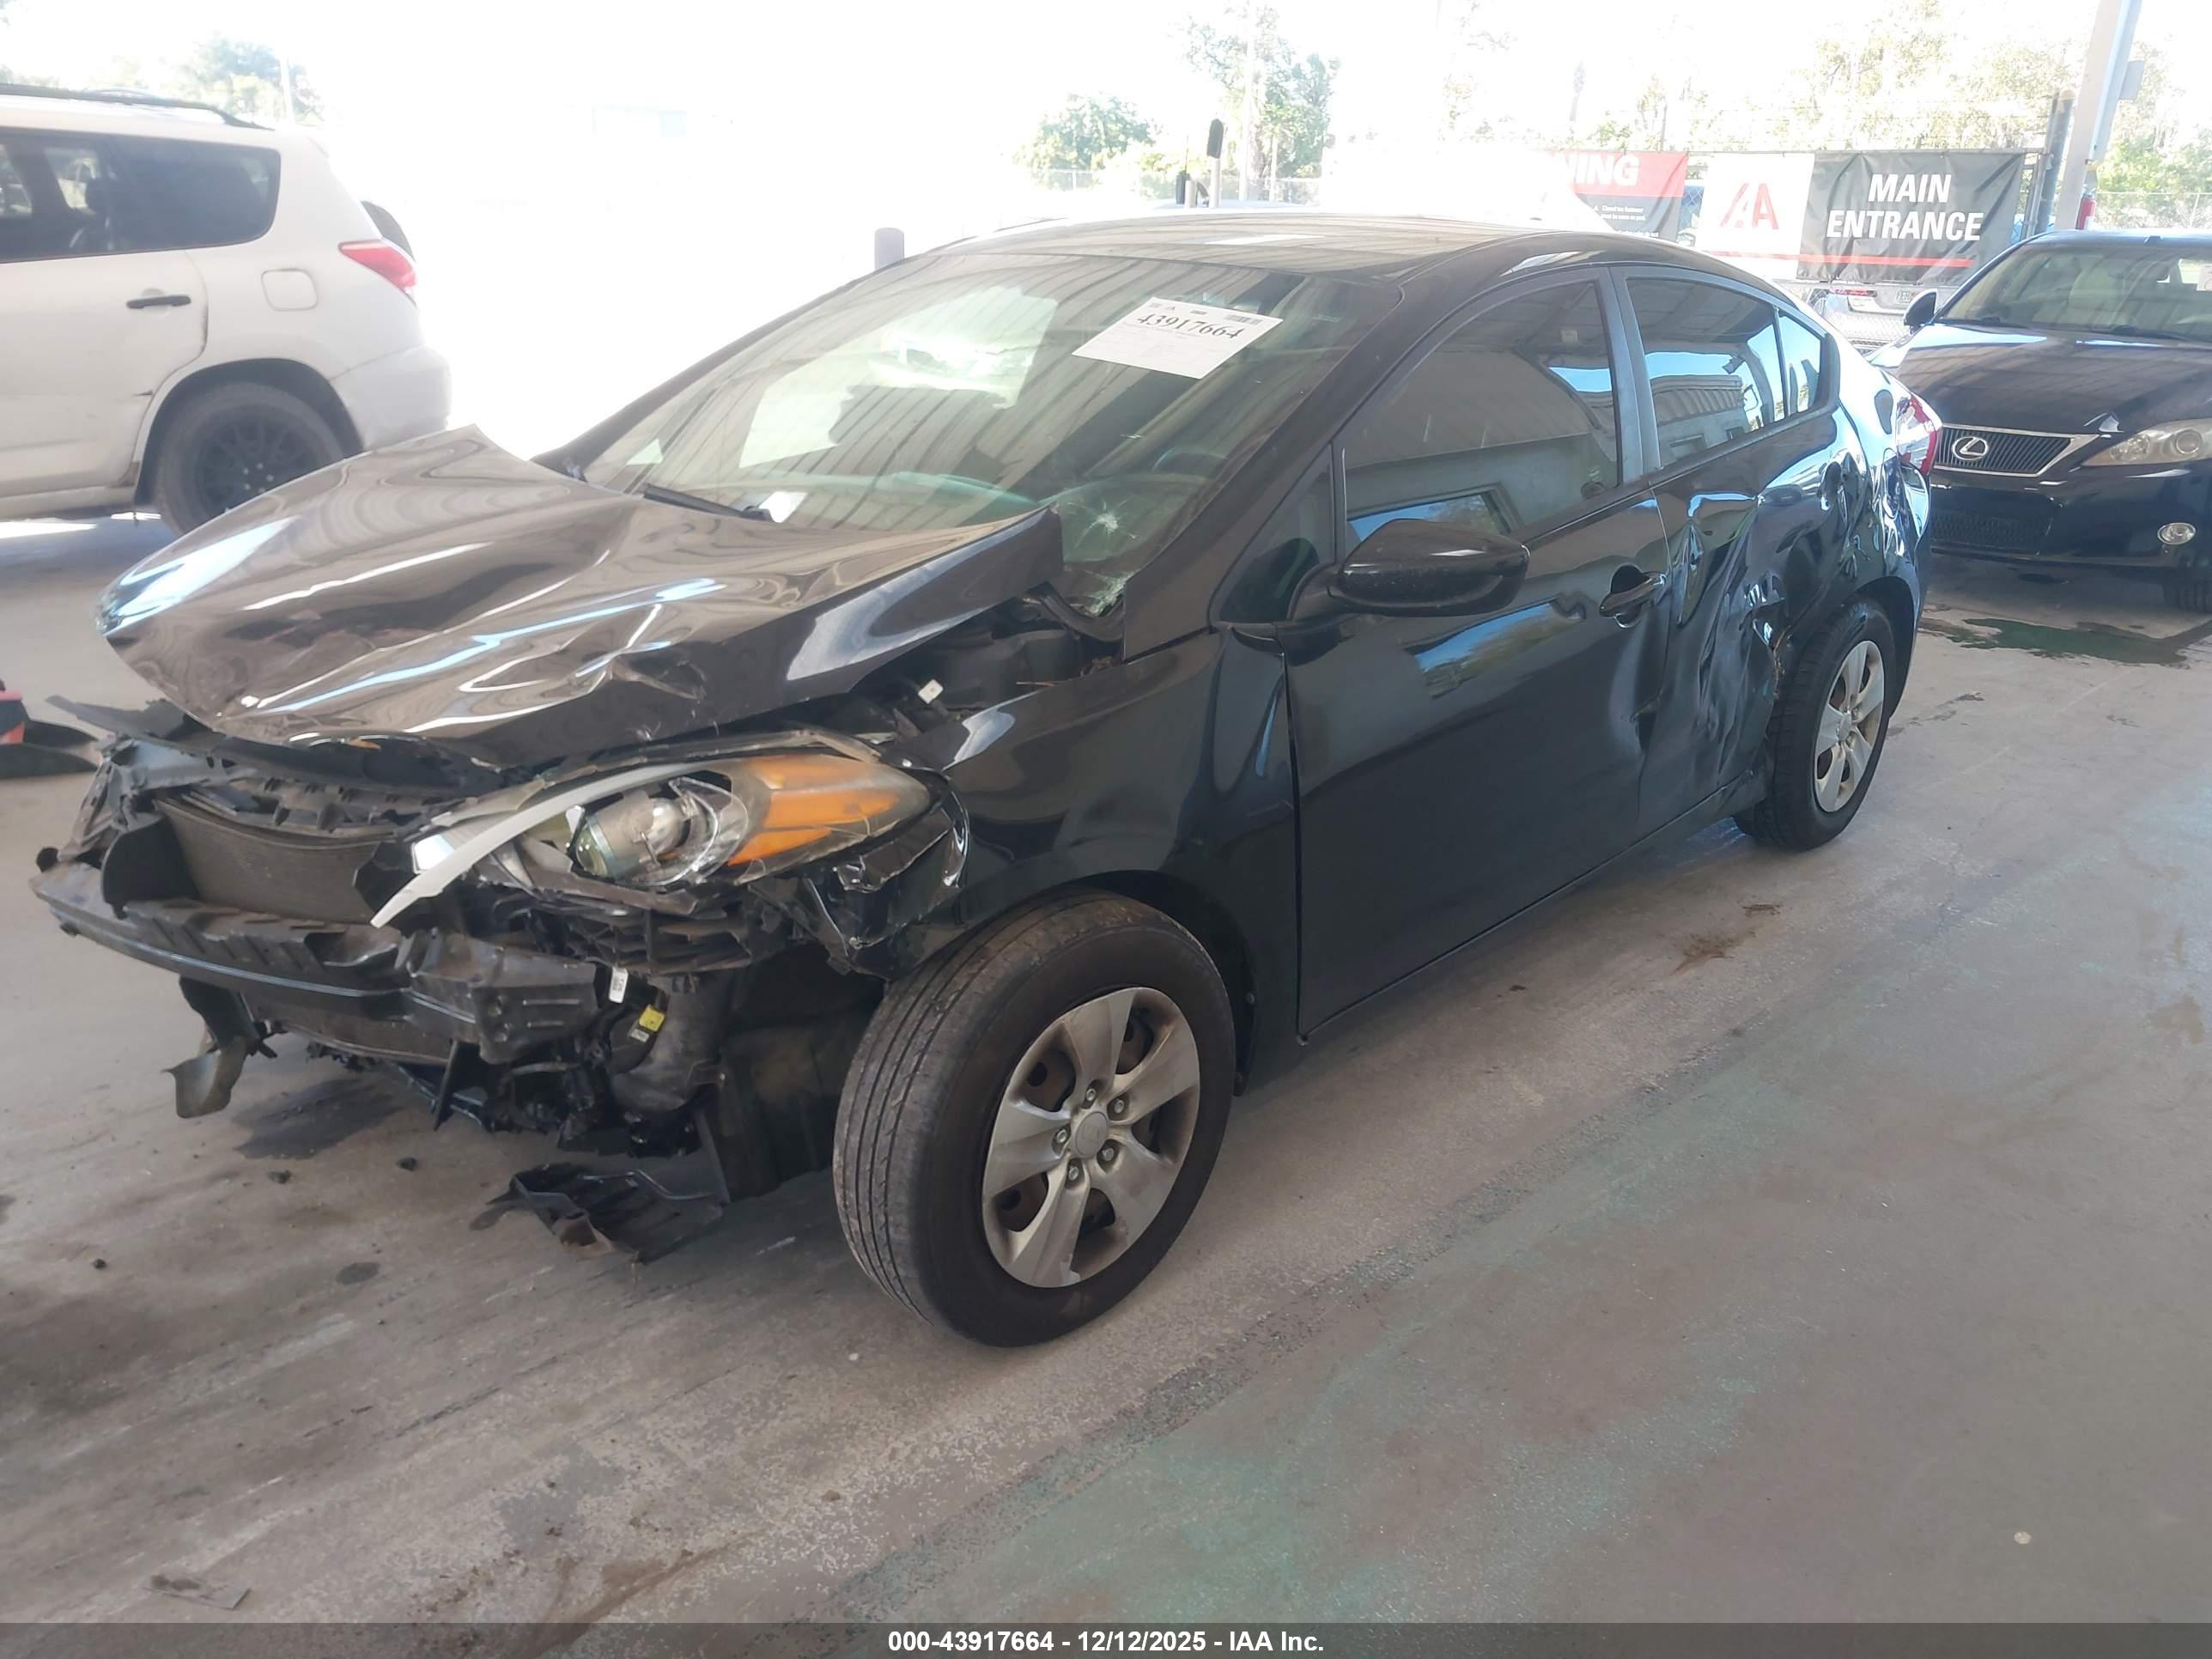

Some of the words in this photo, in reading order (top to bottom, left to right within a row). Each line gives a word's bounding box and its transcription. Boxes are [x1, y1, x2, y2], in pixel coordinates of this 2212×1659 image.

[1868, 173, 1952, 203] MAIN
[1826, 210, 1984, 241] ENTRANCE
[1136, 313, 1246, 339] 43917664
